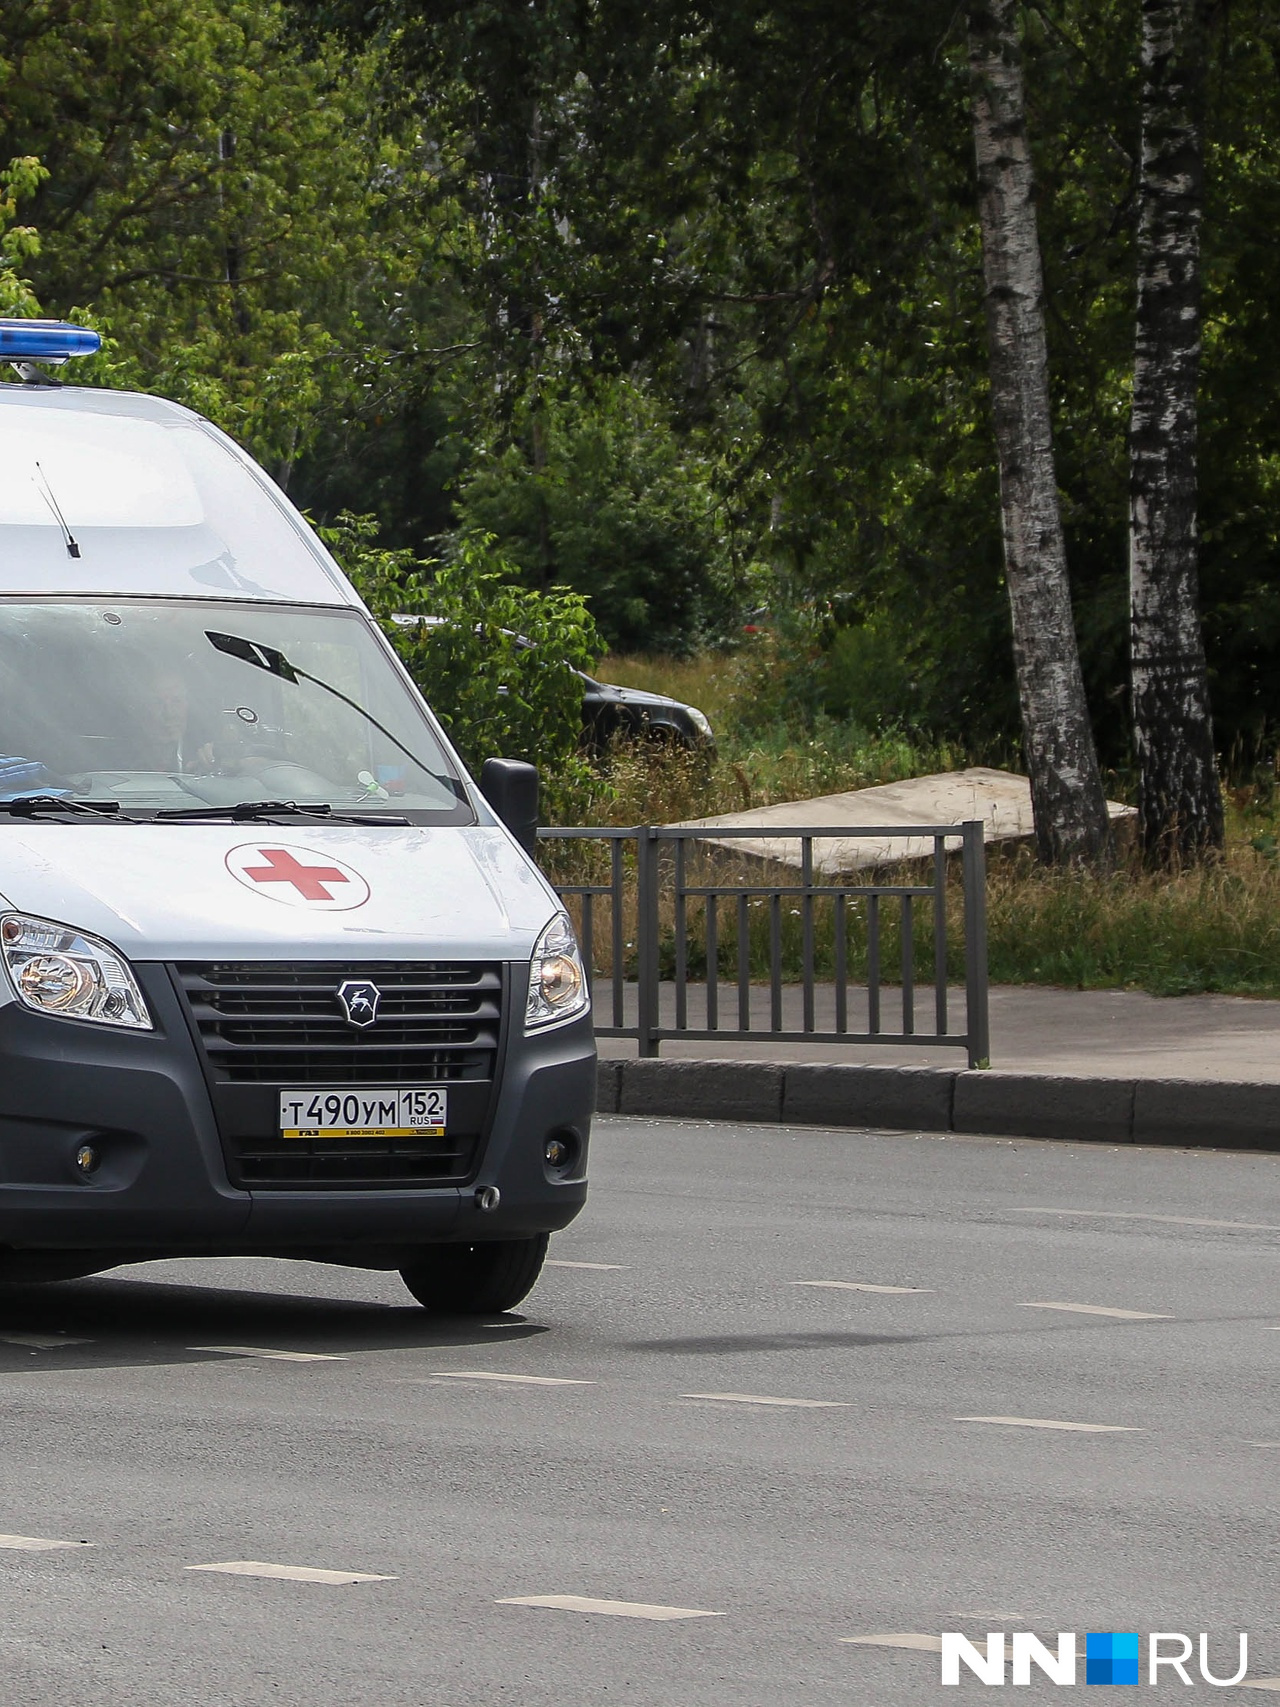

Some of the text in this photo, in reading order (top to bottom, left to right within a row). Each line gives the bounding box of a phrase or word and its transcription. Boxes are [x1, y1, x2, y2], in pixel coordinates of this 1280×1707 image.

[288, 1091, 440, 1126] Т490УМ 152
[410, 1116, 430, 1125] RUS
